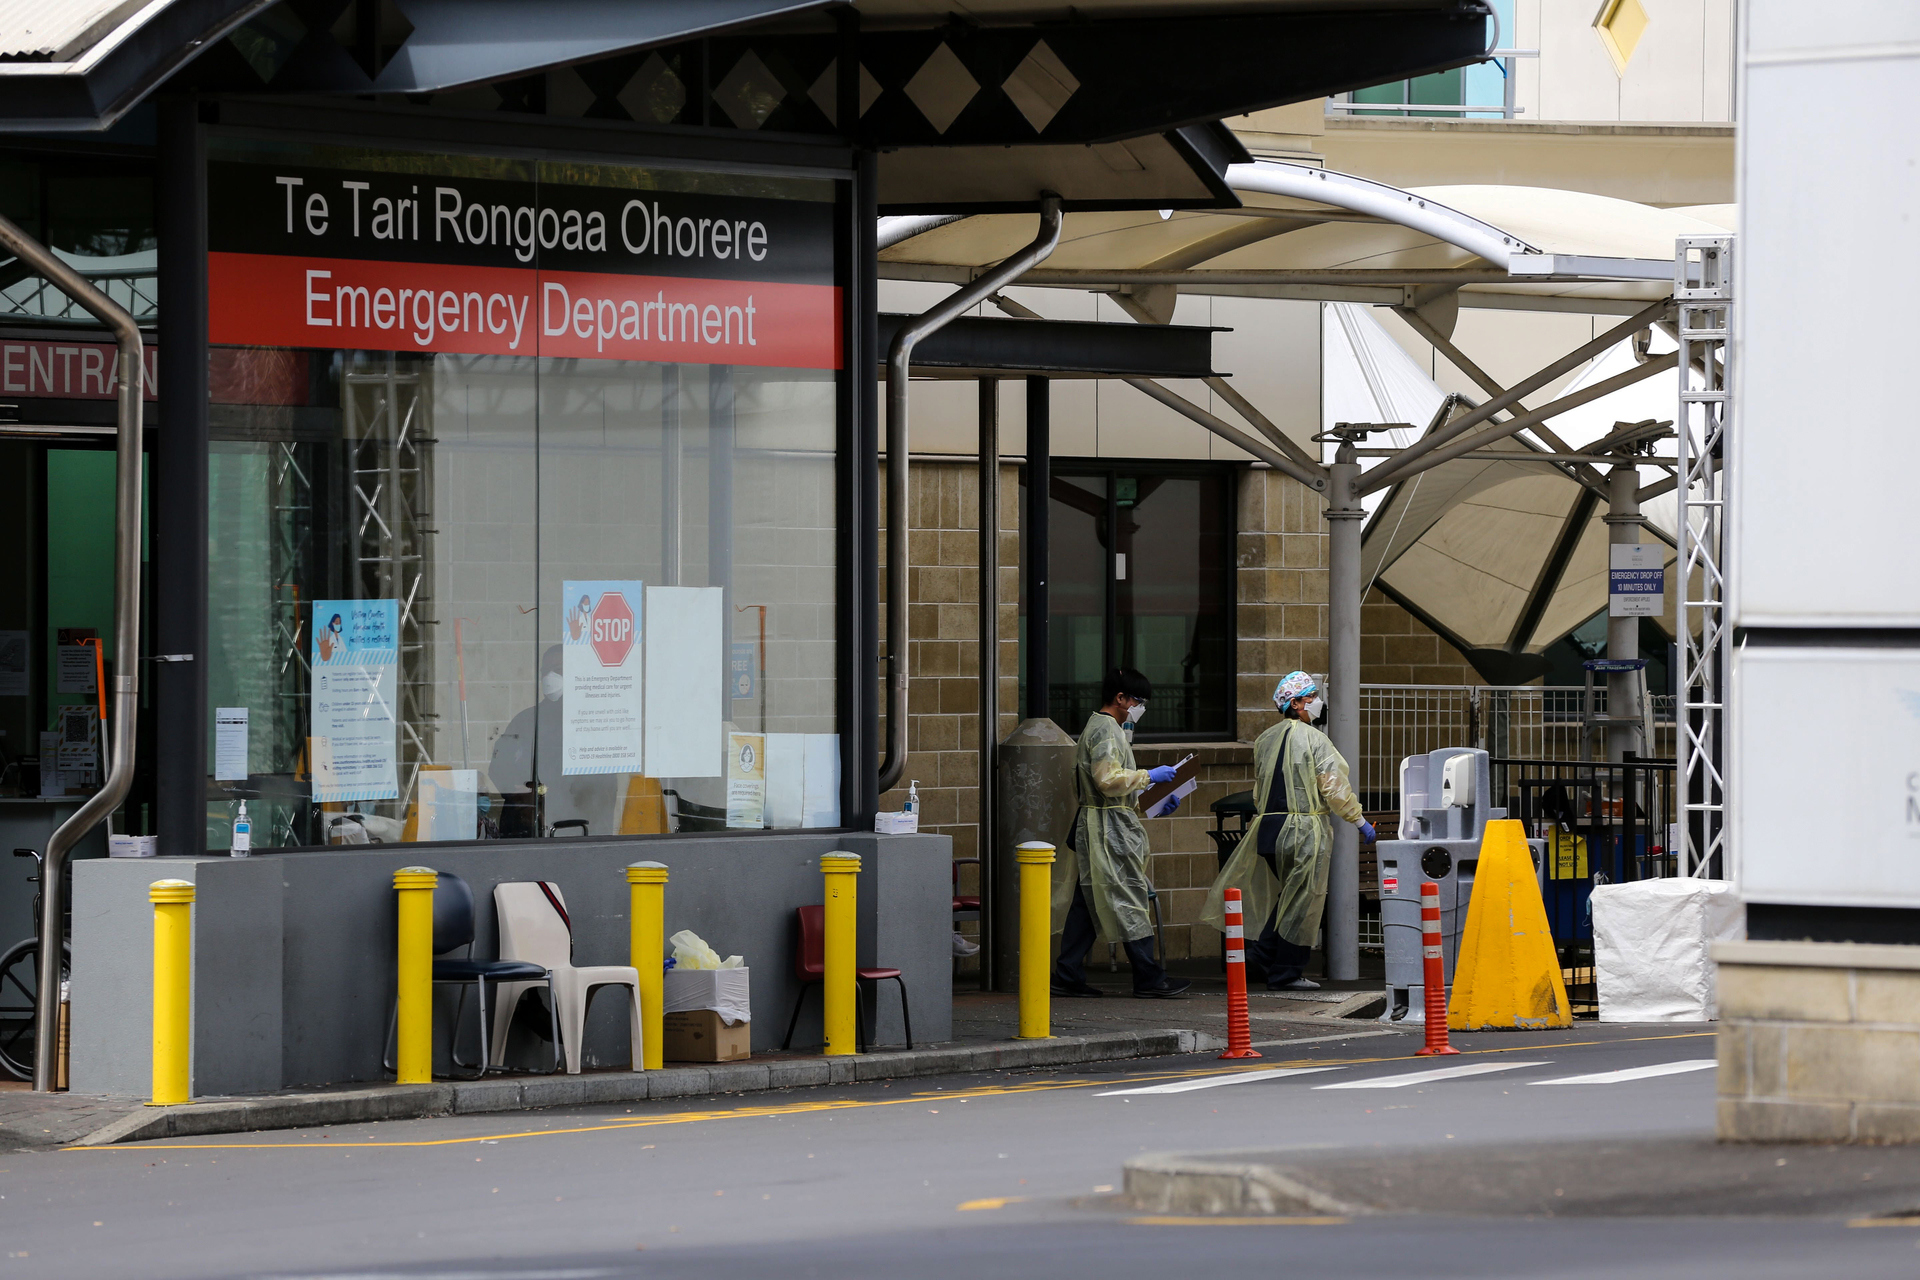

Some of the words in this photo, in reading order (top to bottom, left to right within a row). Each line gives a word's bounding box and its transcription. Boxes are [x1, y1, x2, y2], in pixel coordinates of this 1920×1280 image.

[275, 176, 329, 236] Te
[342, 180, 418, 241] Tari
[435, 186, 607, 263] Rongoaa
[621, 199, 768, 262] Ohorere
[305, 269, 529, 350] Emergency
[542, 281, 757, 353] Department
[1611, 571, 1639, 580] EMERGENCY
[1640, 571, 1653, 580] DROP
[1653, 571, 1663, 580] OFF
[1617, 583, 1622, 591] 10
[1623, 583, 1643, 591] MINUTES
[1644, 583, 1657, 591] ONLY
[594, 618, 631, 642] STOP
